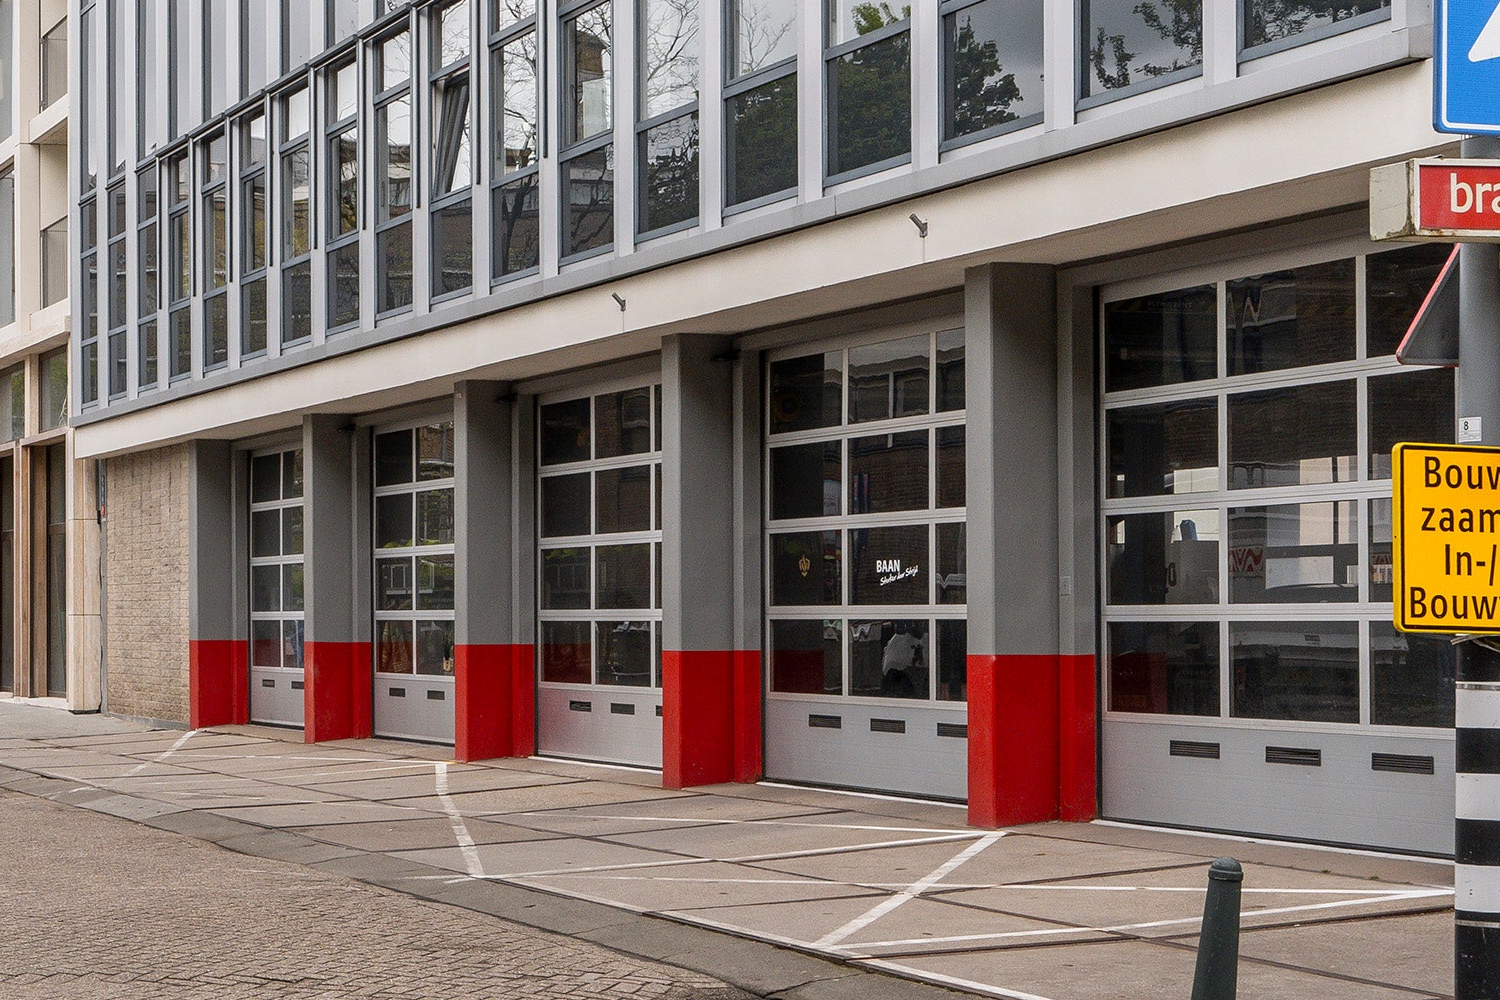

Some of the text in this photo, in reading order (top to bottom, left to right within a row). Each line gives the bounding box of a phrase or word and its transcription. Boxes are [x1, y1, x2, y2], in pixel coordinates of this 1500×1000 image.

[1463, 420, 1469, 431] 8
[876, 559, 900, 573] BAAN
[1445, 544, 1496, 586] In-/
[1410, 586, 1500, 619] Bouw
